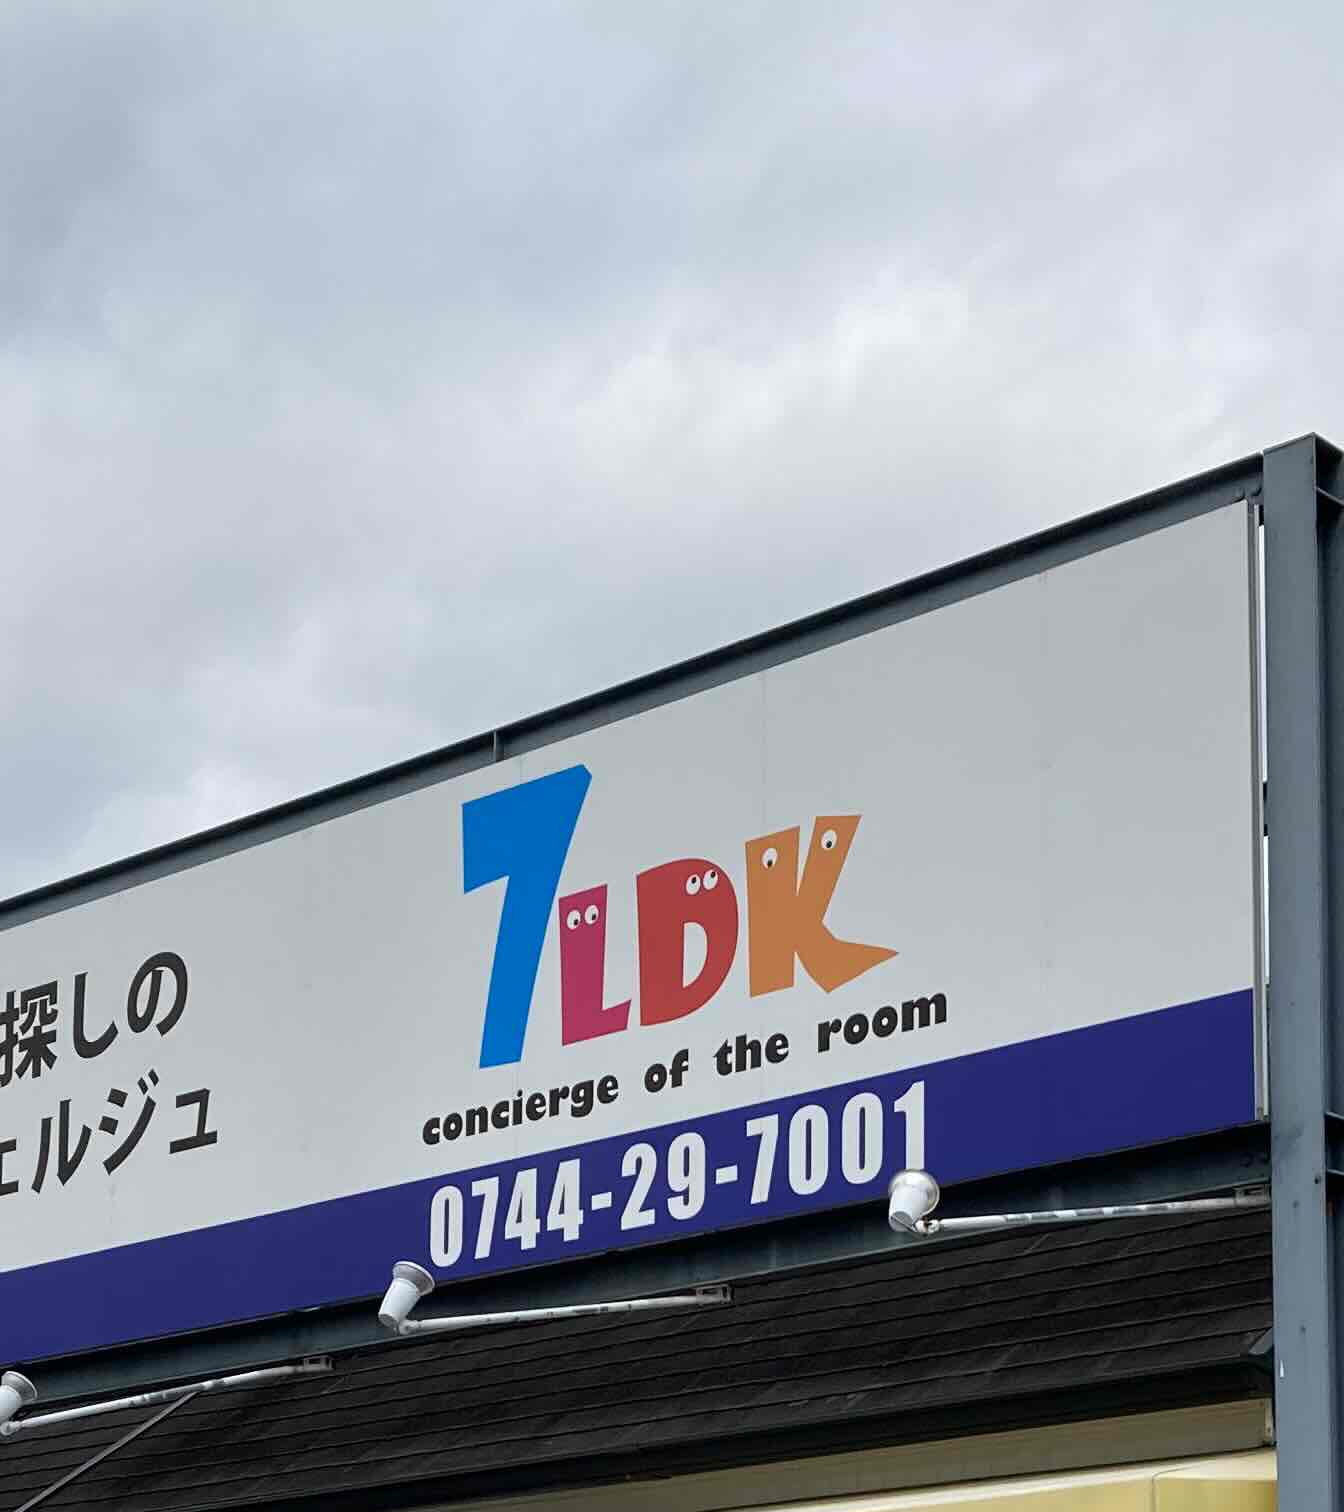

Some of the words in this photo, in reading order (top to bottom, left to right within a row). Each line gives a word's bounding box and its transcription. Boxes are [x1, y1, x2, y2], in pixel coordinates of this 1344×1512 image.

[461, 763, 900, 1070] 7LDK
[421, 1073, 620, 1146] concierge
[643, 1048, 690, 1093] of
[713, 1031, 790, 1077] the
[816, 991, 949, 1054] room
[429, 1079, 926, 1269] 0744-29-7001
